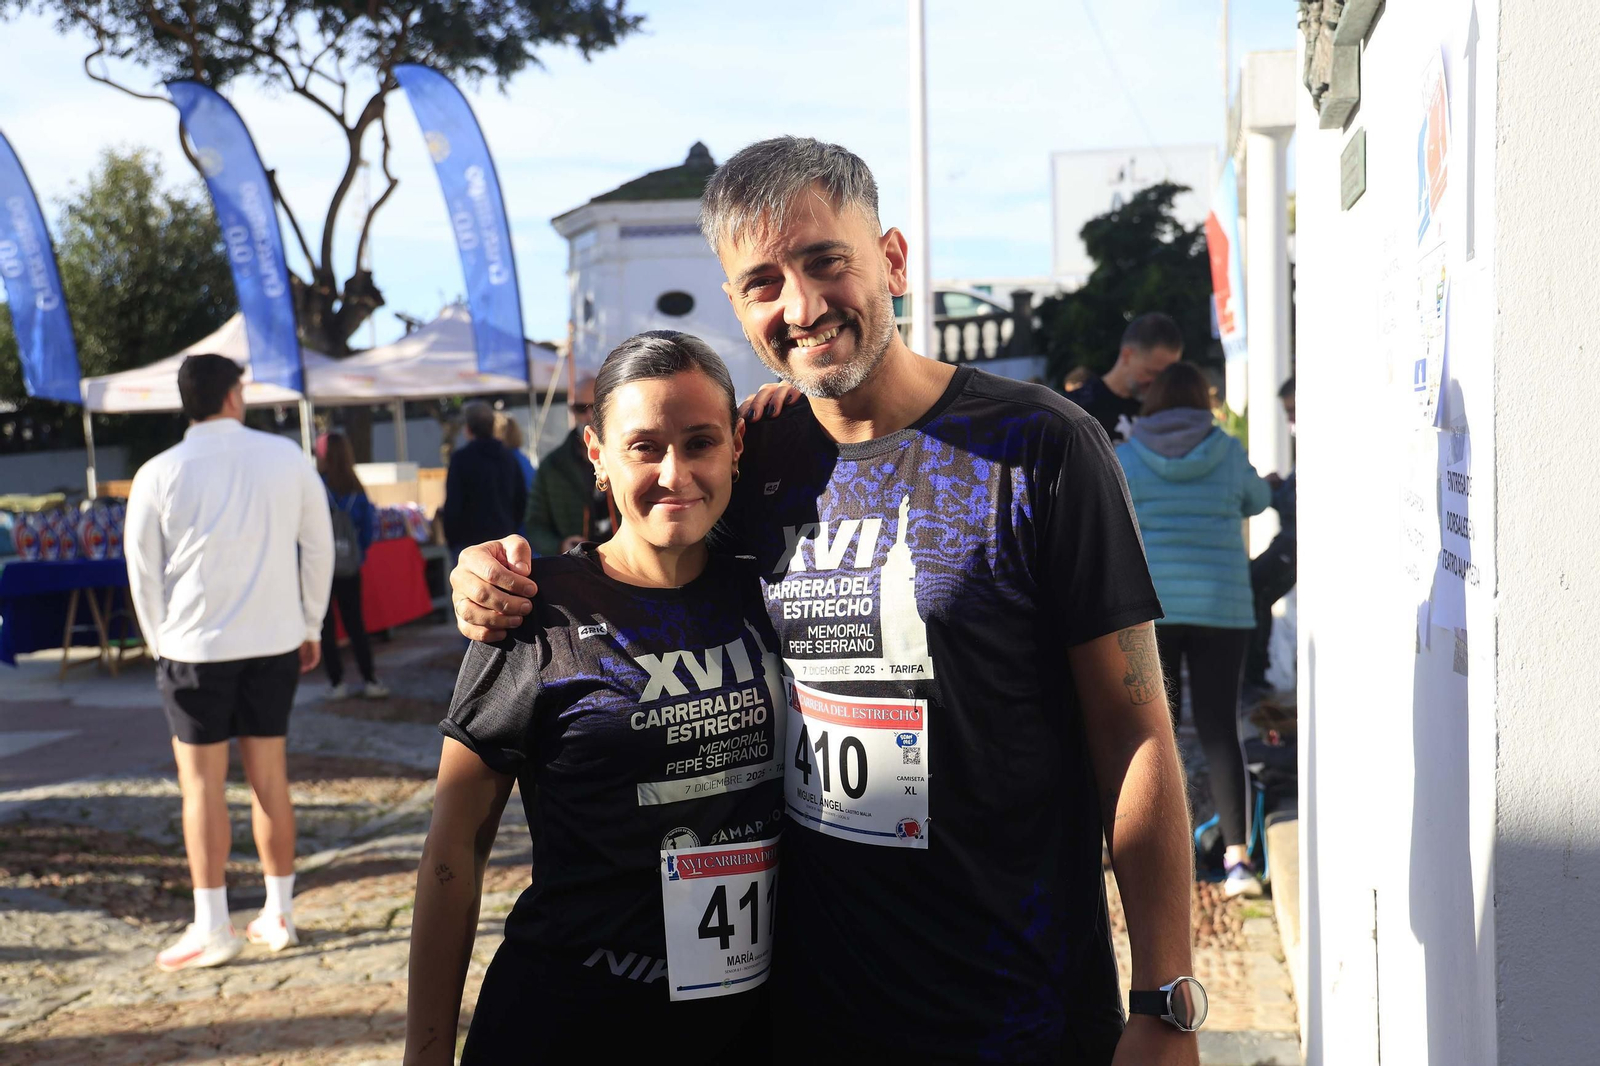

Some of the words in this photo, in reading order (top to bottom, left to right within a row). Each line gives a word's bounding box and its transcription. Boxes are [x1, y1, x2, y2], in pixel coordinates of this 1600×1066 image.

[1447, 471, 1466, 496] ENTREGA
[1447, 511, 1468, 540] DORSALES
[772, 518, 882, 574] XVI
[768, 578, 837, 600] CARRERA
[839, 576, 873, 596] DEL
[783, 597, 874, 620] ESTRECHO
[808, 623, 875, 639] MEMORIAL
[789, 640, 814, 654] PEPE
[815, 637, 875, 653] SERRANO
[634, 637, 754, 703] XVI
[802, 666, 807, 675] 7
[853, 665, 876, 674] 2025
[889, 664, 924, 674] TARIFA
[631, 695, 729, 730] CARRERA
[729, 687, 765, 711] DEL
[800, 694, 829, 715] CARRERA
[831, 704, 851, 718] DEL
[852, 708, 920, 721] ESTRECHO
[667, 707, 767, 745] ESTRECHO
[698, 730, 767, 756] MEMORIAL
[665, 757, 703, 776] PEPE
[705, 743, 769, 768] SERRANO
[795, 724, 868, 800] 410
[685, 785, 691, 794] 7
[694, 775, 743, 793] DICIEMBRE
[746, 769, 765, 782] 2025
[904, 786, 917, 795] XL
[797, 788, 818, 805] MIGUEL
[819, 796, 844, 812] ÁNGEL
[681, 858, 702, 870] XVI
[704, 853, 760, 868] CARRERA
[698, 875, 776, 950] 411
[727, 951, 754, 967] MARÍA
